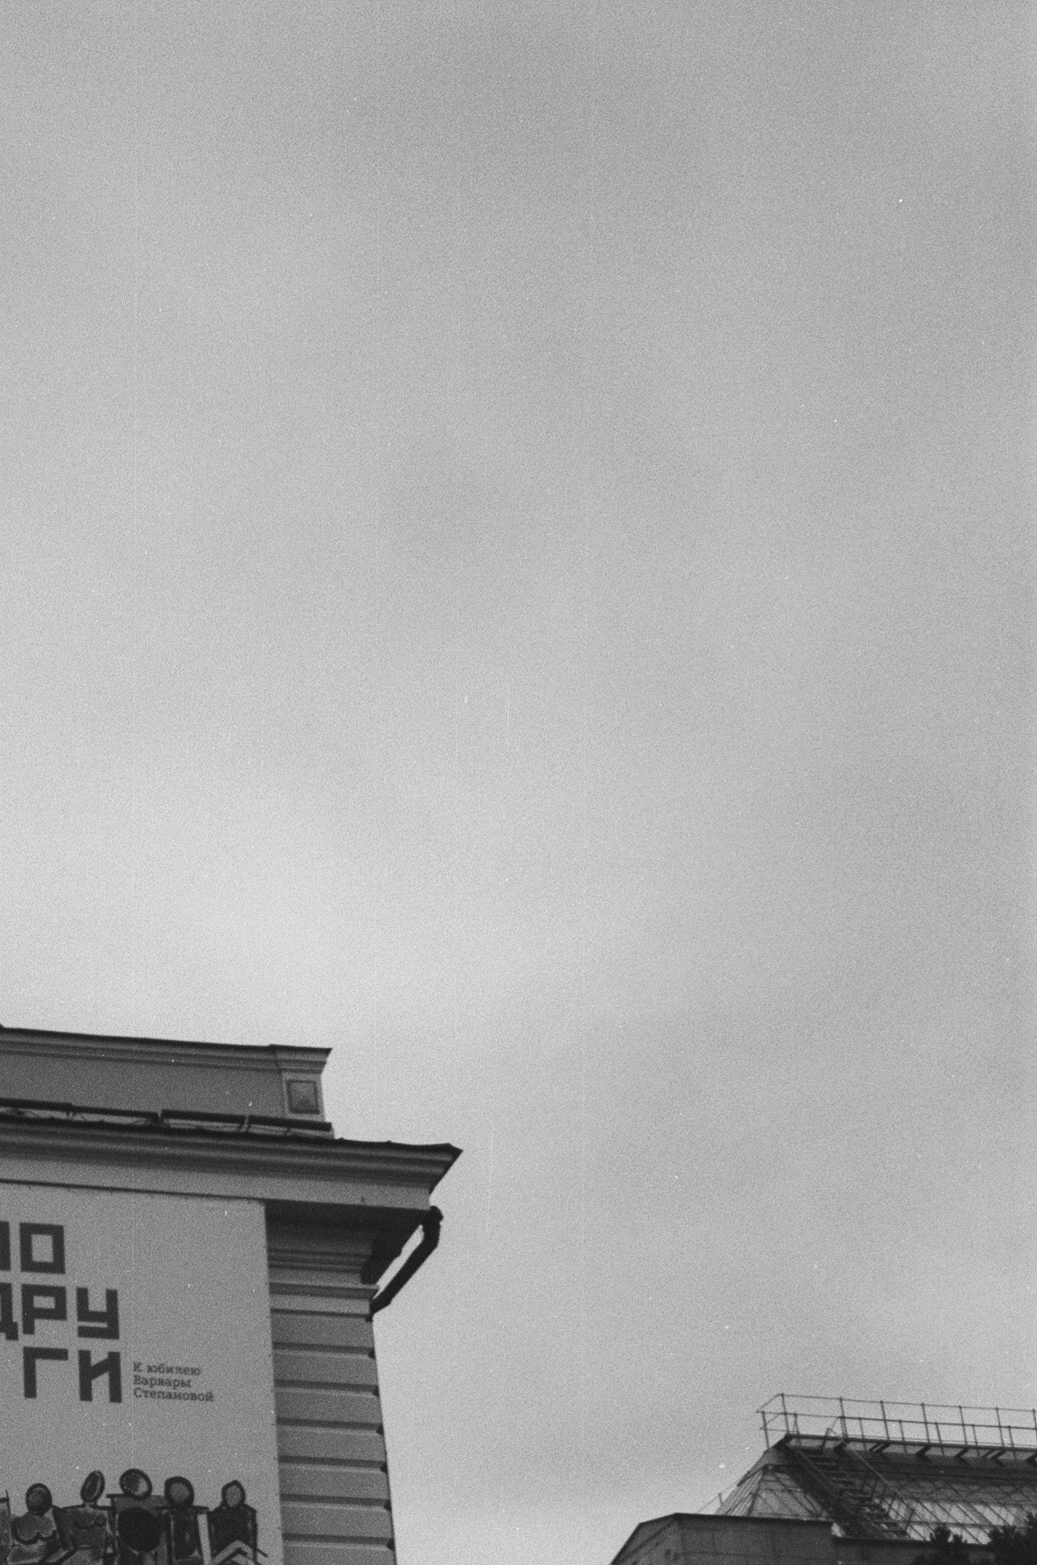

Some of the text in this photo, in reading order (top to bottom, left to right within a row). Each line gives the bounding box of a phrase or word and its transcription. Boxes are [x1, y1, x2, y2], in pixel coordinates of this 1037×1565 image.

[23, 1346, 123, 1403] ГИ
[133, 1362, 202, 1376] К юбилею
[133, 1374, 192, 1390] Варвары
[133, 1387, 214, 1402] Степановой
